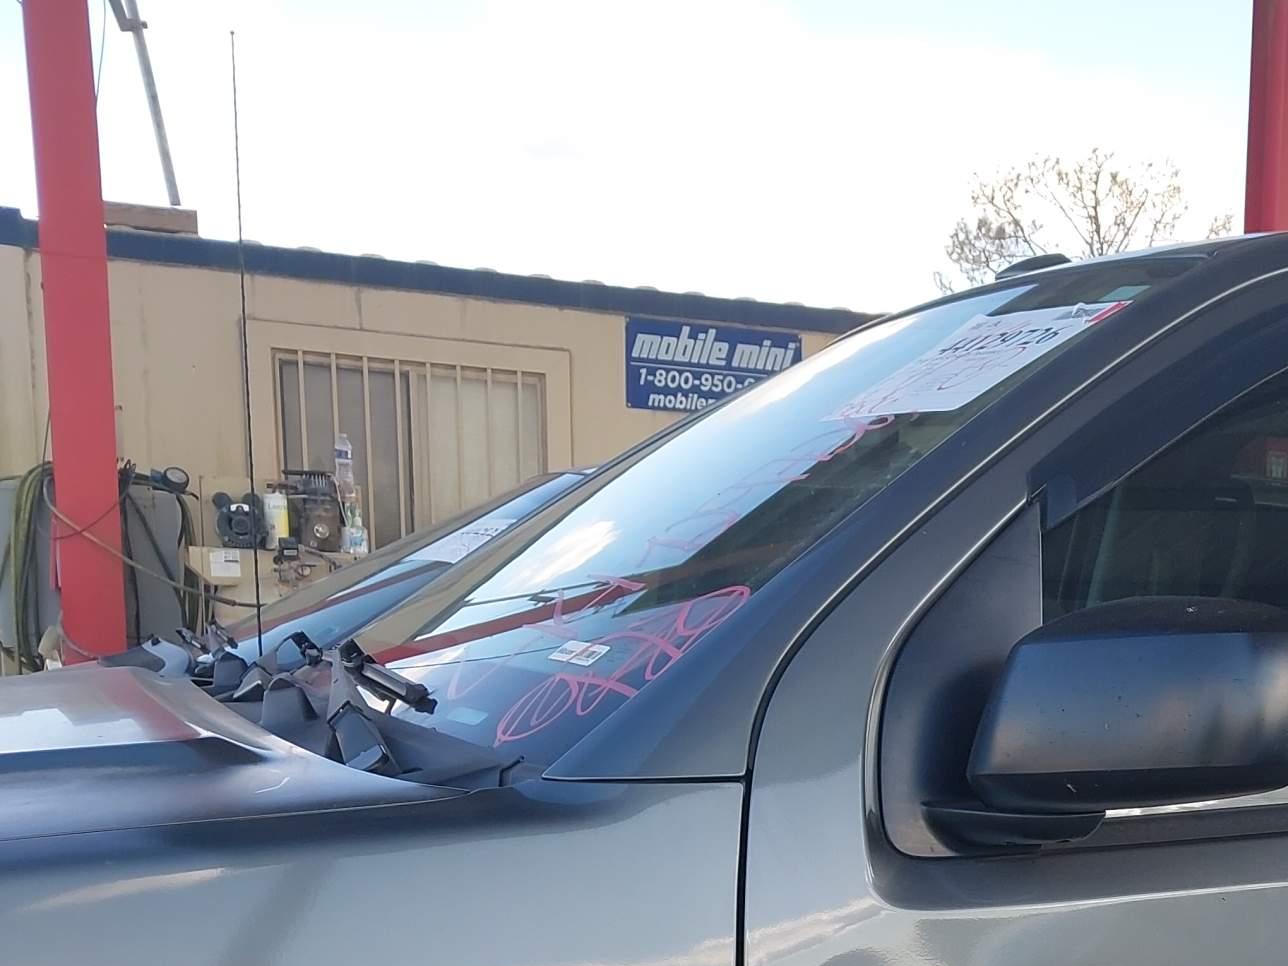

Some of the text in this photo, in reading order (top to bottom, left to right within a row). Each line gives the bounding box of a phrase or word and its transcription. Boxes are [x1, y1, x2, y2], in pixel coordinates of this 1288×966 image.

[631, 325, 797, 371] mobile mini
[648, 392, 717, 410] mobile
